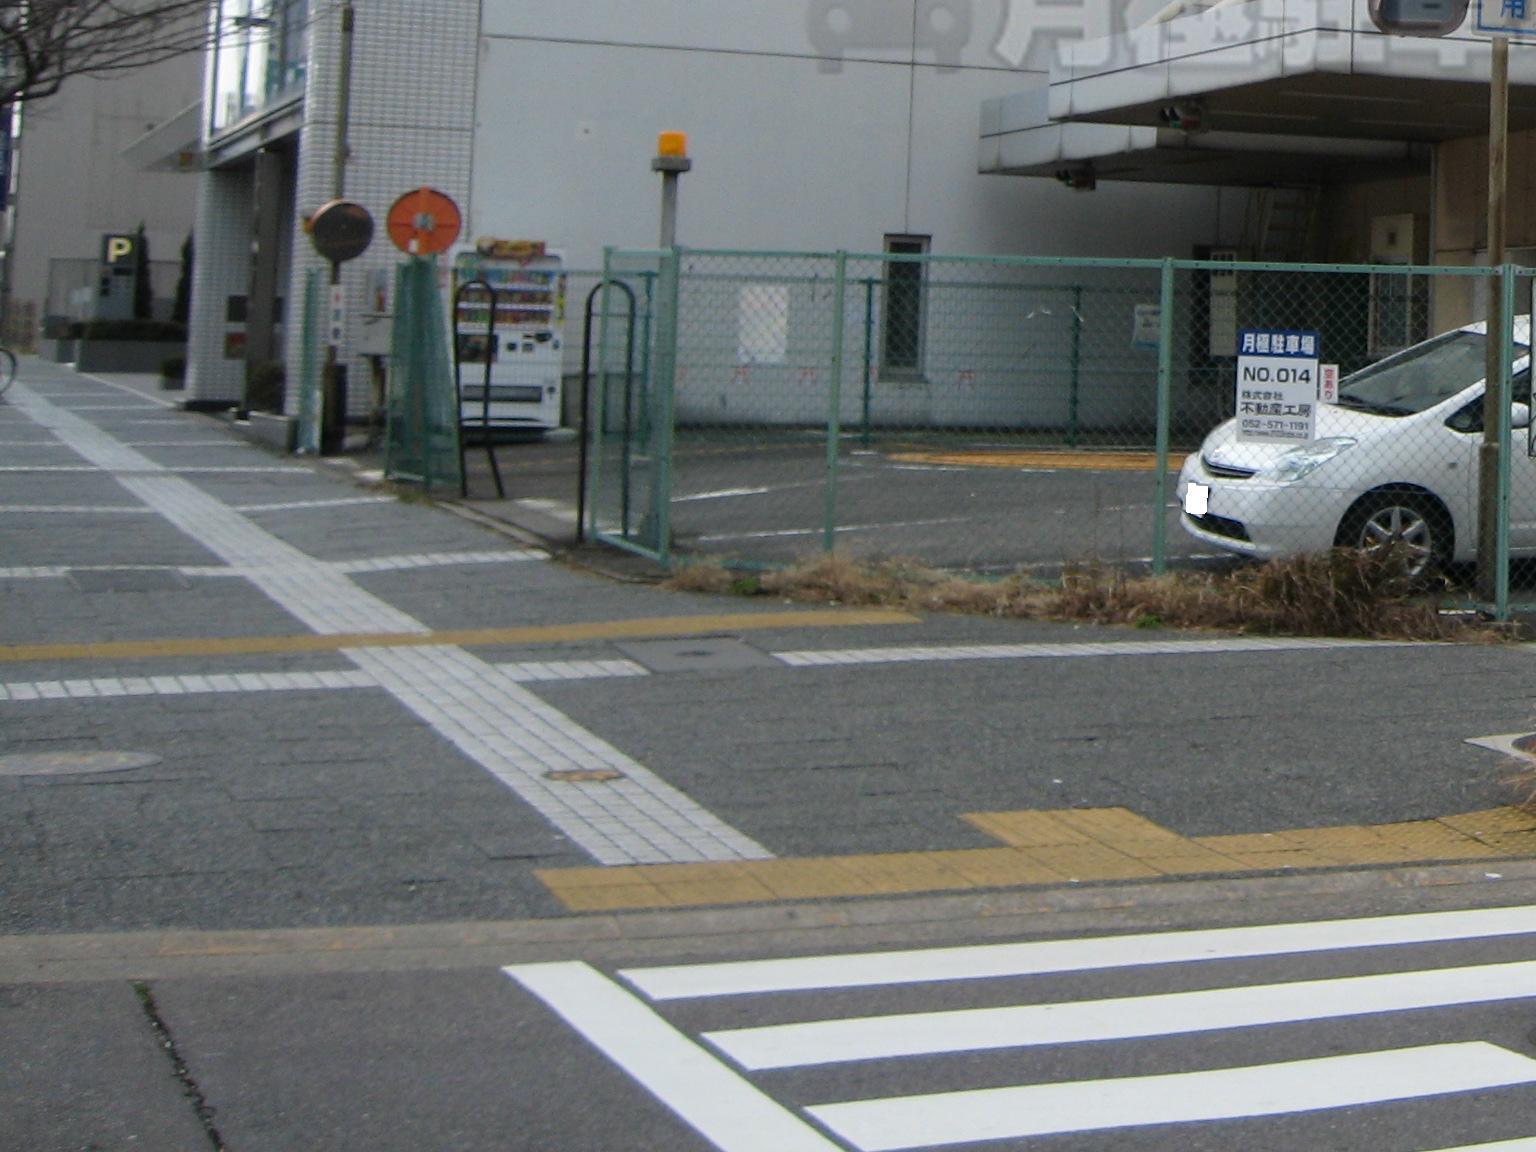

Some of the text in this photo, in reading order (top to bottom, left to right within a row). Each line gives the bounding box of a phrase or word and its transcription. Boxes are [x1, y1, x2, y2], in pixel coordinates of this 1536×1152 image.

[106, 236, 132, 263] P
[1242, 332, 1315, 355] 月極駐車場
[1243, 366, 1311, 384] NO.014
[1241, 390, 1284, 401] 株式会社
[1240, 401, 1312, 418] 不動産工房
